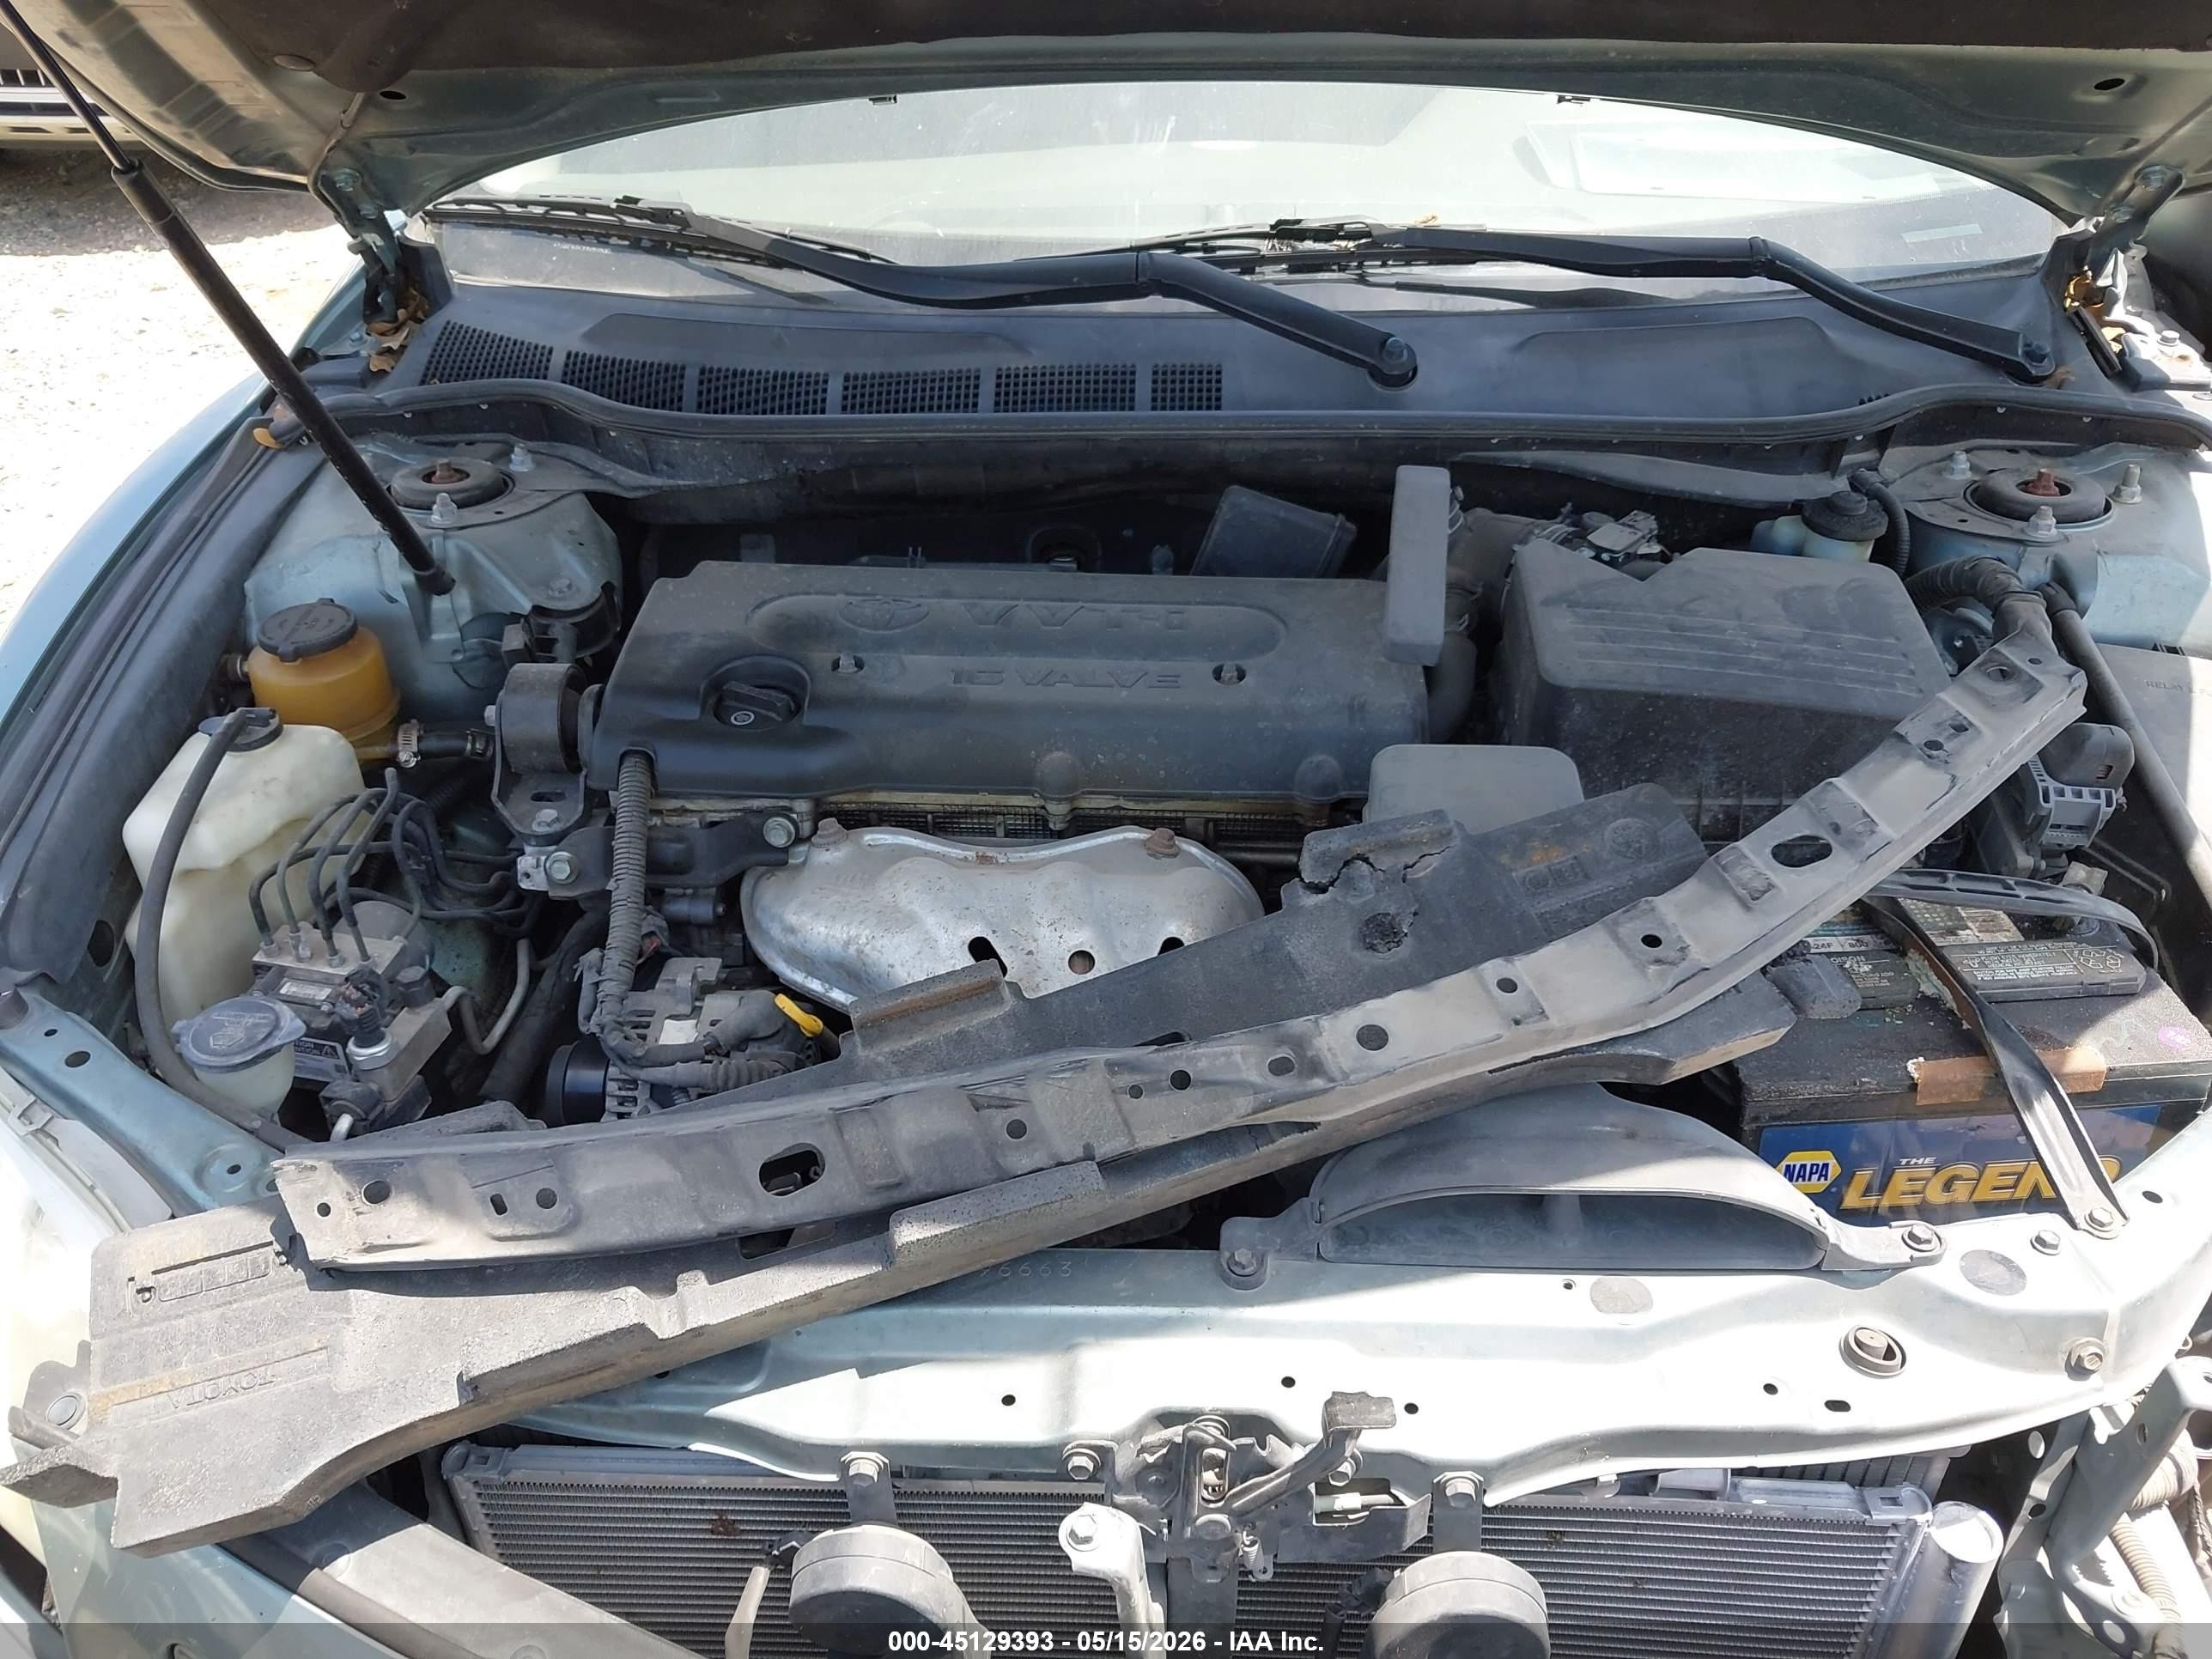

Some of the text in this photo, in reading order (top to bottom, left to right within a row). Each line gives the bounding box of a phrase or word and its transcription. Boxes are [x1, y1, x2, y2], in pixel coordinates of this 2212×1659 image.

[1014, 667, 1182, 689] VALVE
[1784, 1161, 1831, 1183] NAPA
[1899, 1157, 1936, 1165] THE
[167, 1370, 276, 1409] TOYOTA
